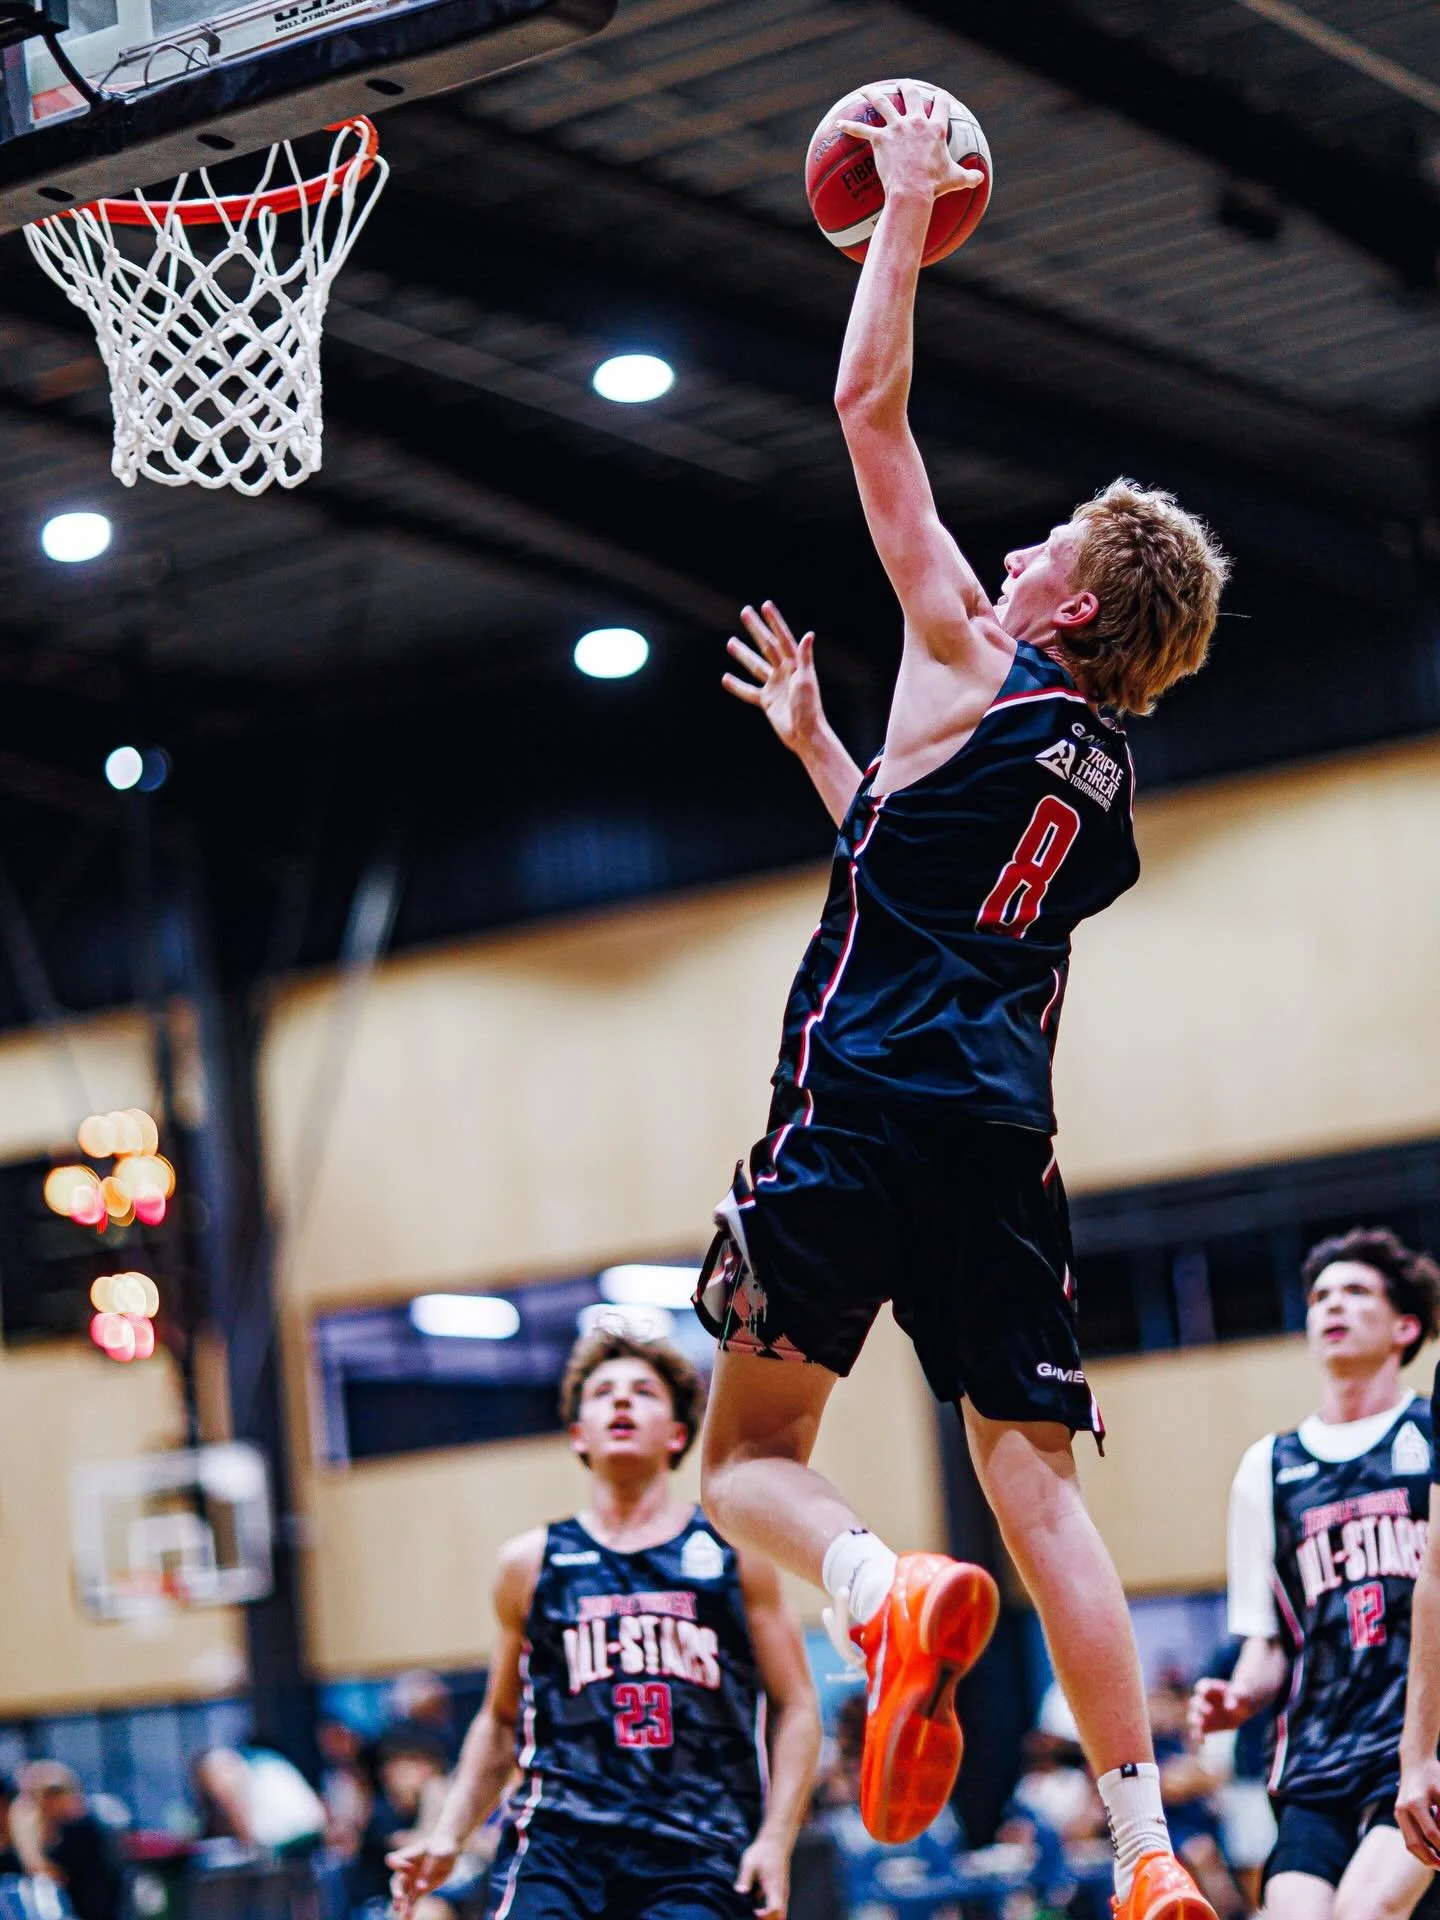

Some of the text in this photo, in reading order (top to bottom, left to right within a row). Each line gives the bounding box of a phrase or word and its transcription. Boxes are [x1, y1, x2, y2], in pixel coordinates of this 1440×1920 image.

[1076, 759, 1119, 801] THREAT
[1087, 746, 1124, 787] TRIPLE
[974, 794, 1080, 939] 8
[1345, 1581, 1387, 1648] 12
[612, 1681, 675, 1749] 23
